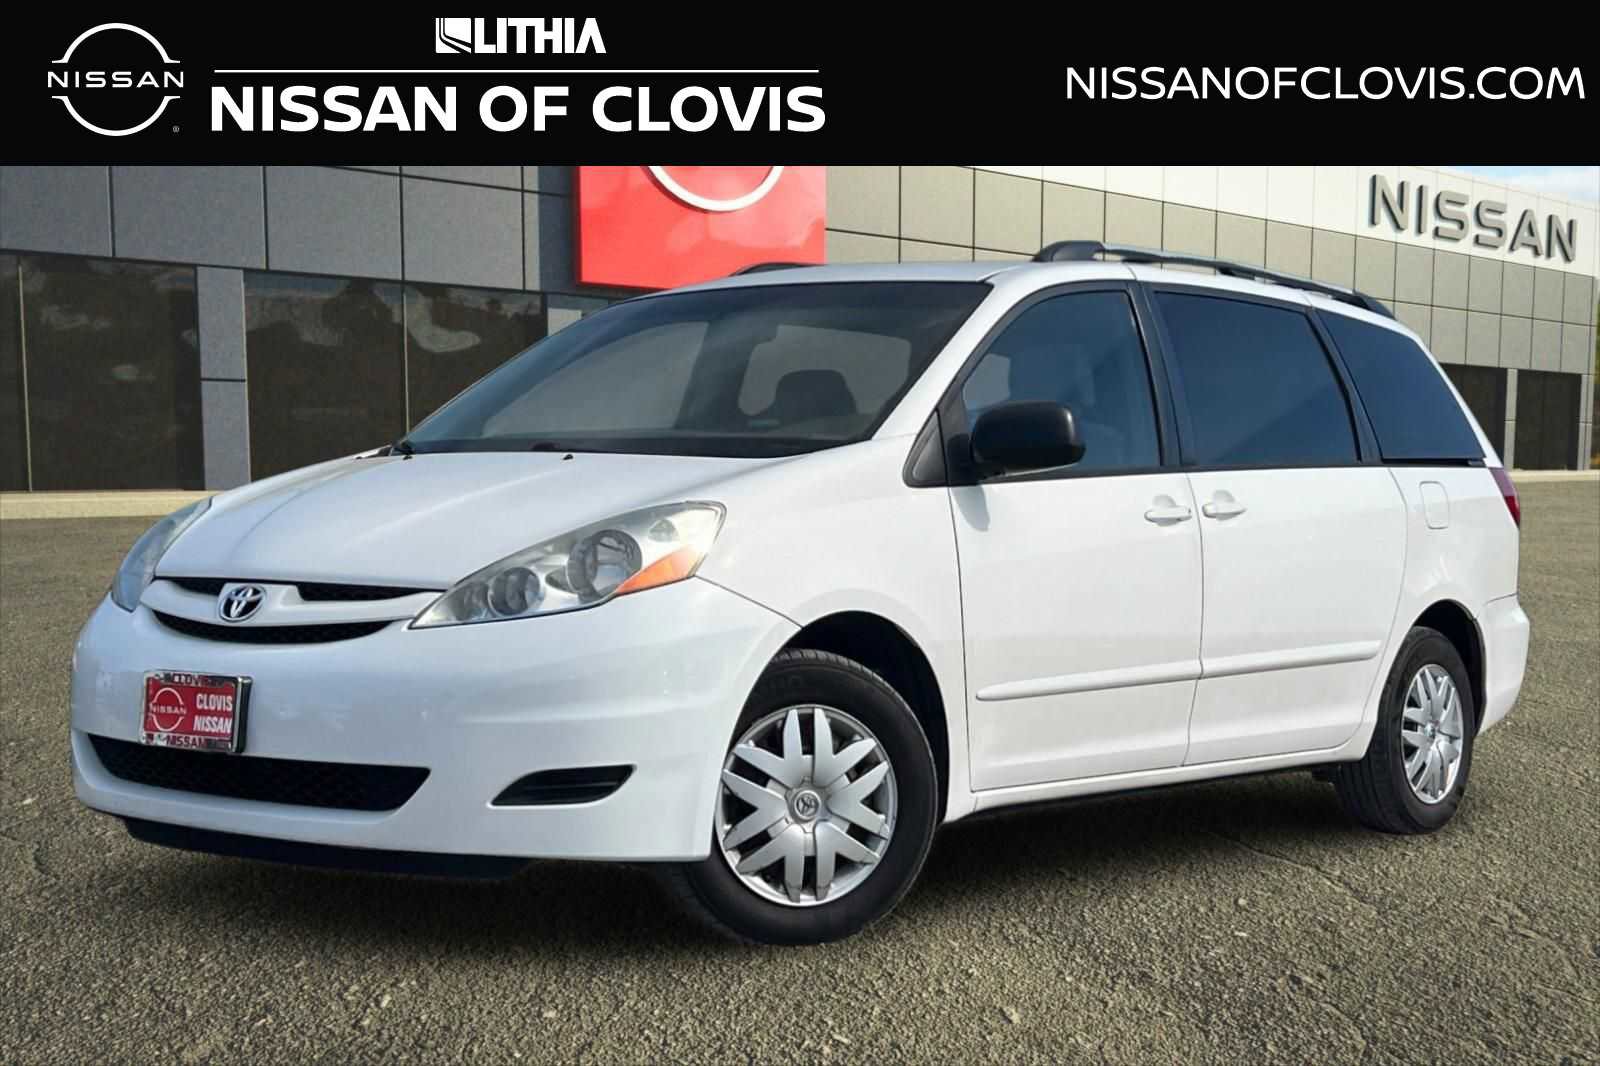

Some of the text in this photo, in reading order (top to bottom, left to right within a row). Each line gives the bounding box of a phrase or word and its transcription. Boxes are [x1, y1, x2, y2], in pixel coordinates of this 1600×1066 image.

[1368, 173, 1578, 263] NISSAN
[196, 693, 233, 712] CLOVIS
[193, 715, 233, 734] NISSAN
